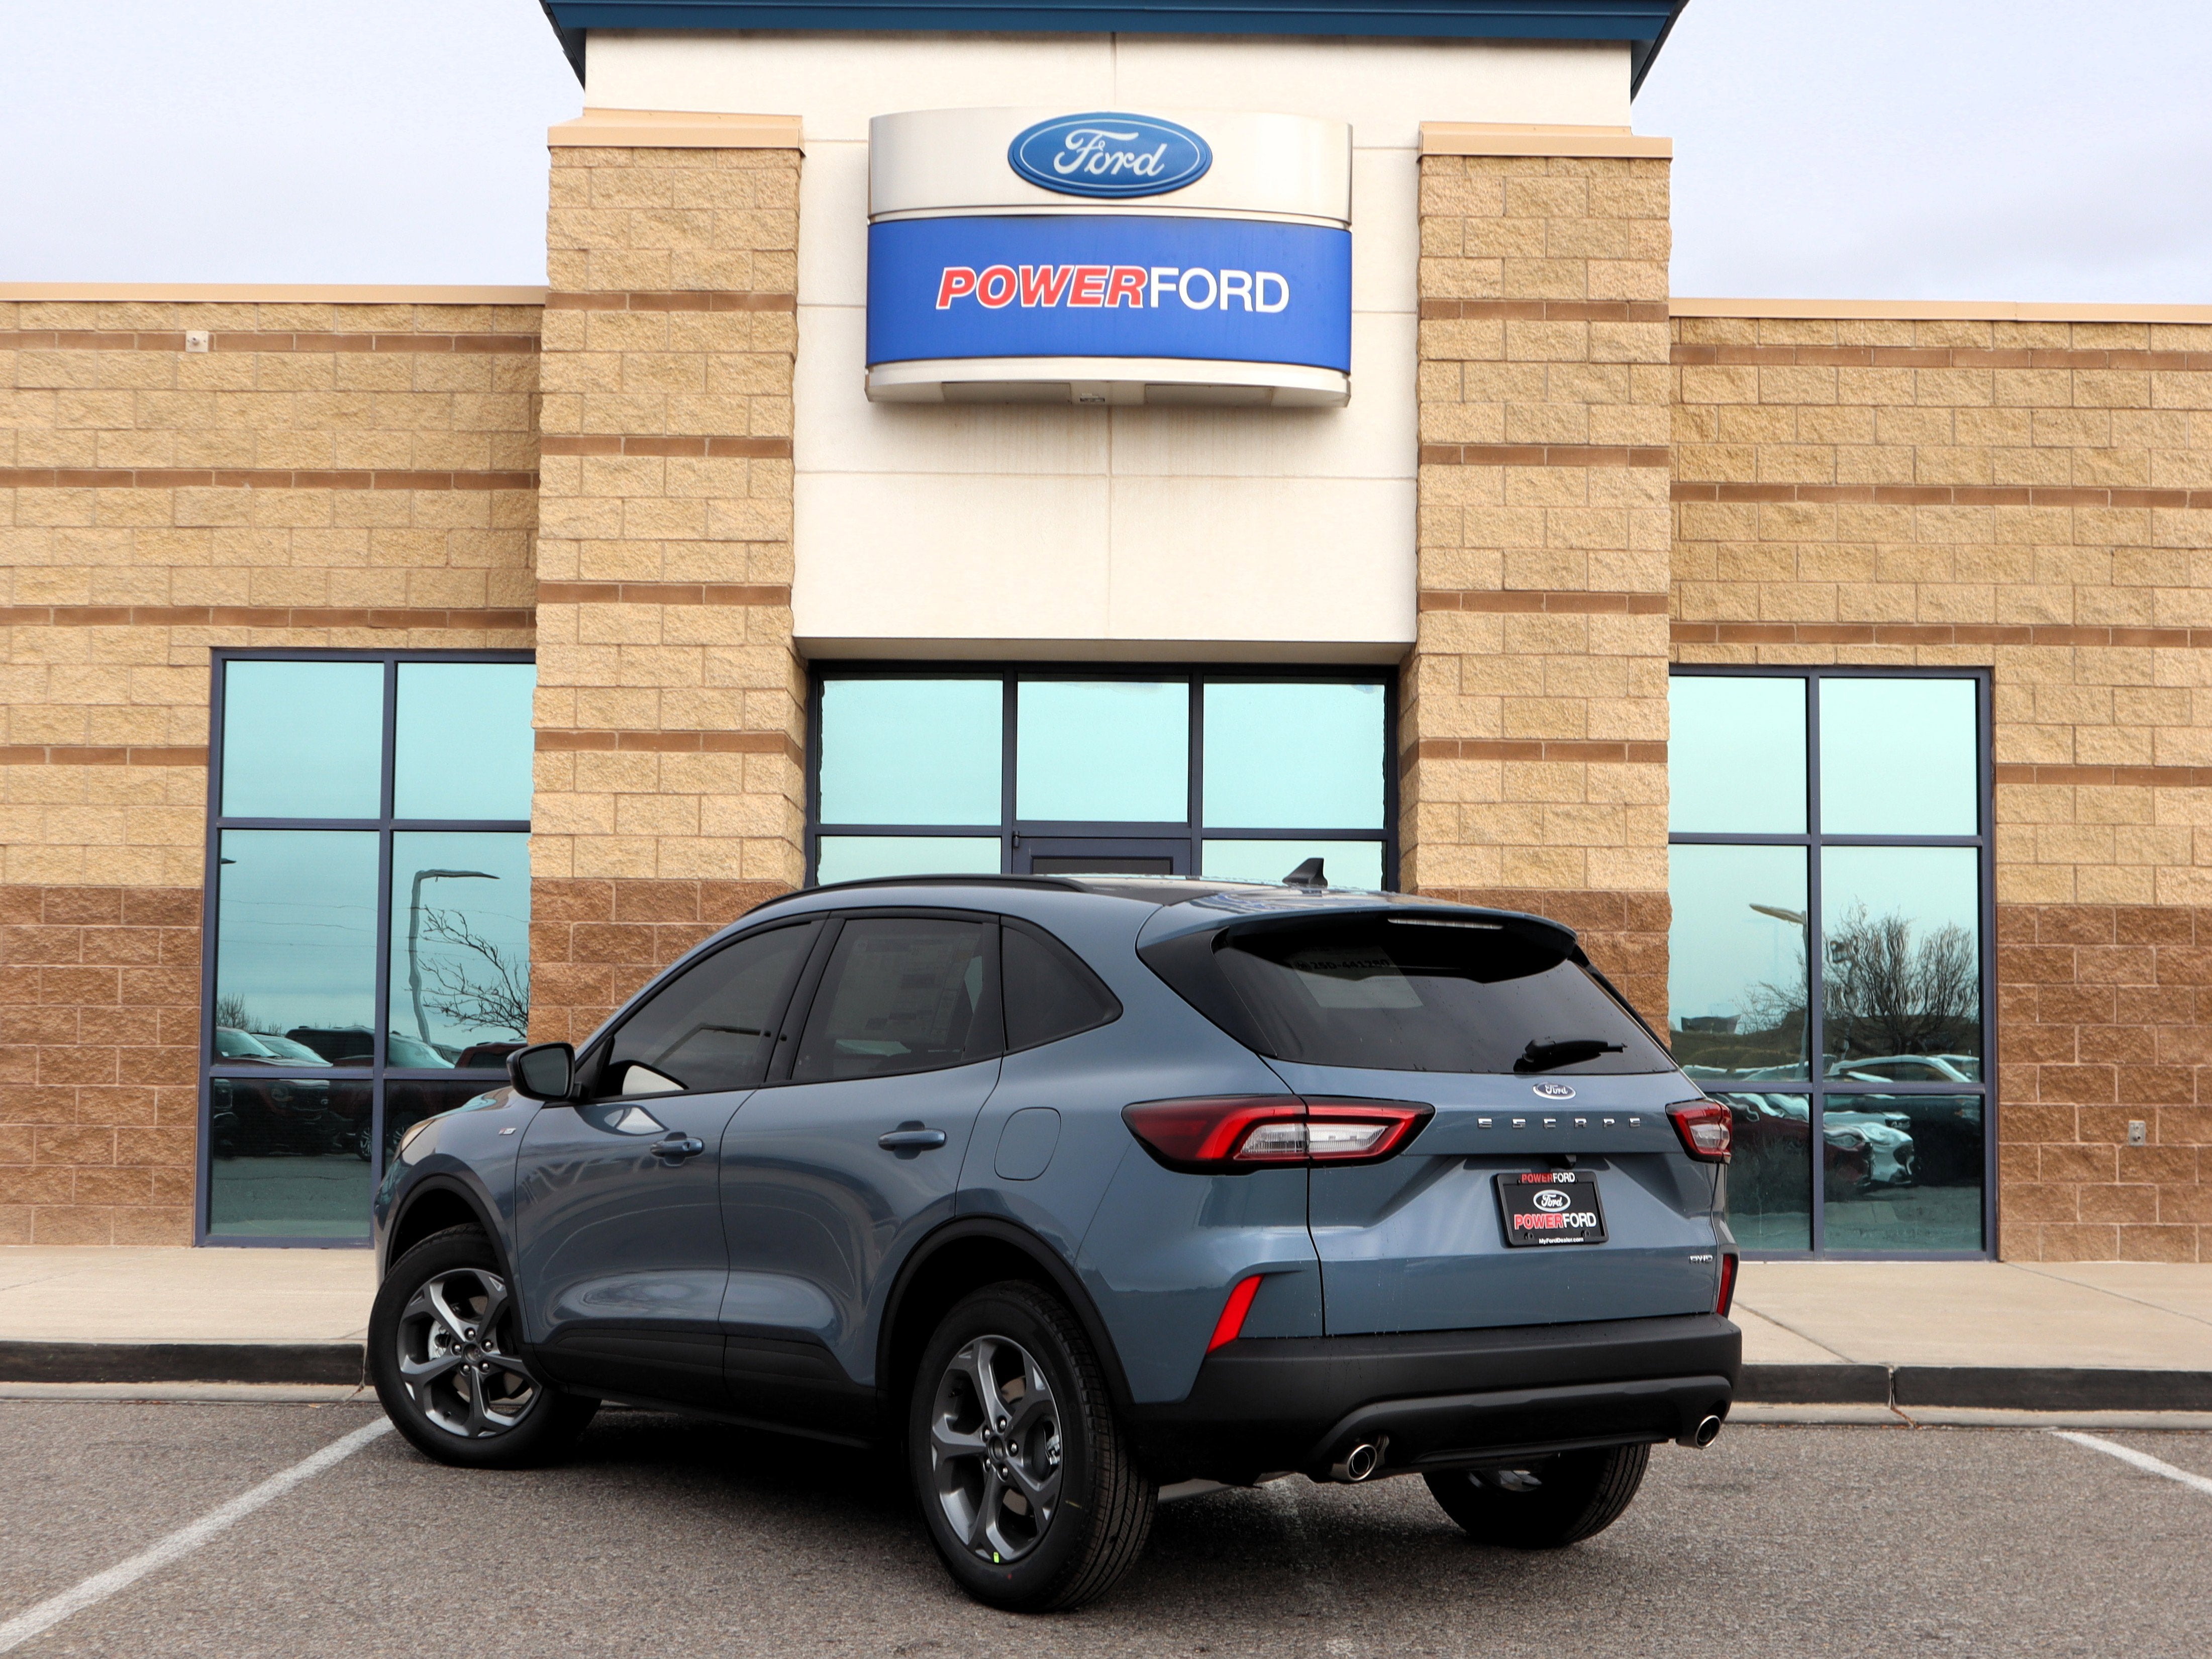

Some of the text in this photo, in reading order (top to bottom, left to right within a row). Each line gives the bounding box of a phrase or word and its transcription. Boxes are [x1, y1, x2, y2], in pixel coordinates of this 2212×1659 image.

[1053, 129, 1168, 176] Ford
[936, 264, 1290, 313] POWERFORD
[1545, 1084, 1568, 1095] Ford
[1478, 1118, 1641, 1128] ESCAPE
[1521, 1172, 1575, 1183] POWERFORD
[1541, 1194, 1563, 1207] Ford
[1514, 1212, 1596, 1230] POWERFORD
